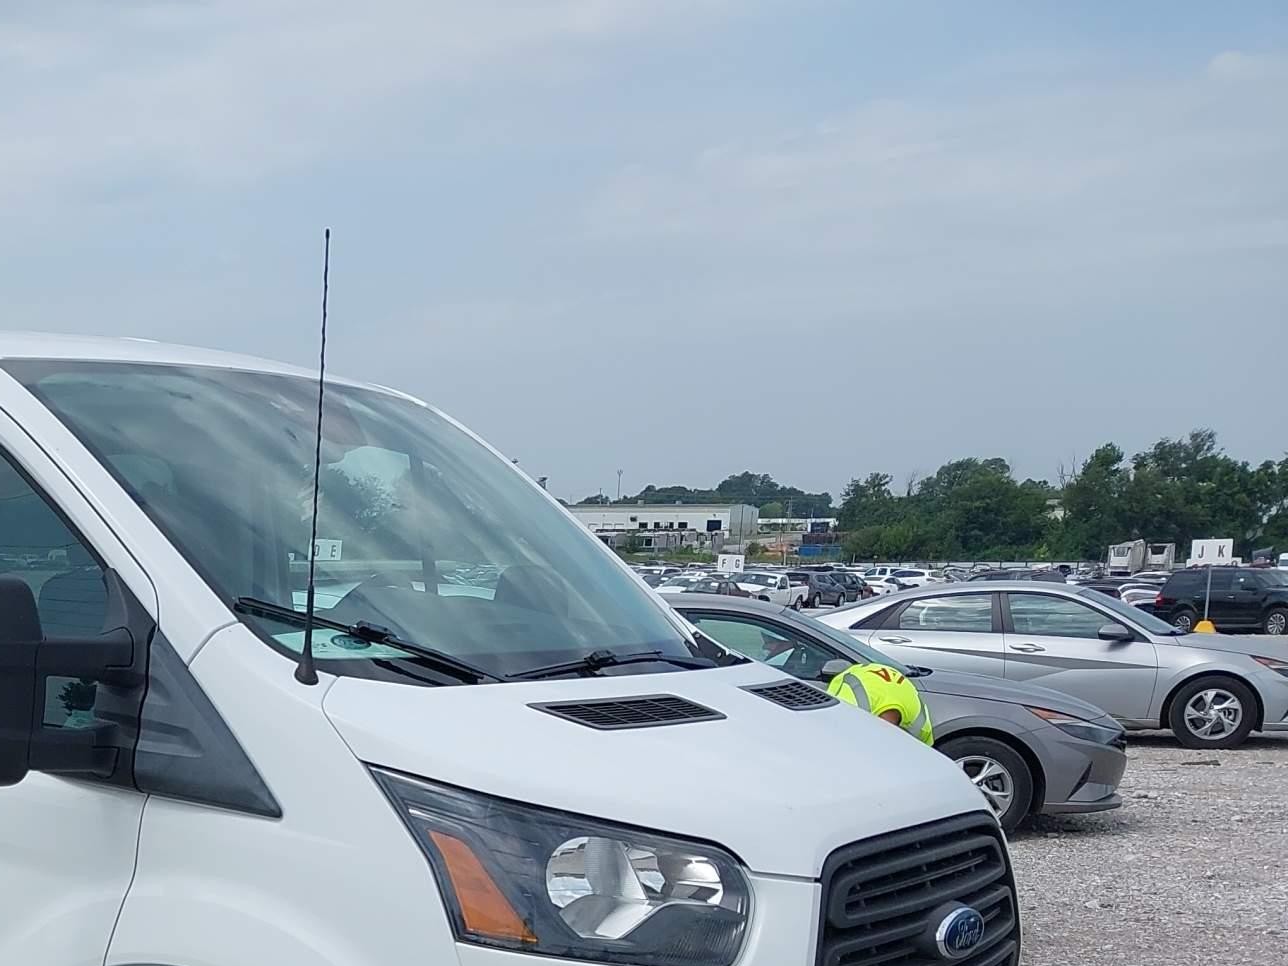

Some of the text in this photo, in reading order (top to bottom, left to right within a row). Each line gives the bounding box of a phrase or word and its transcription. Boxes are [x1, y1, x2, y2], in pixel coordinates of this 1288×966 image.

[330, 544, 337, 557] E
[1198, 544, 1226, 558] J K
[722, 558, 740, 568] F G
[955, 918, 980, 947] Ford
